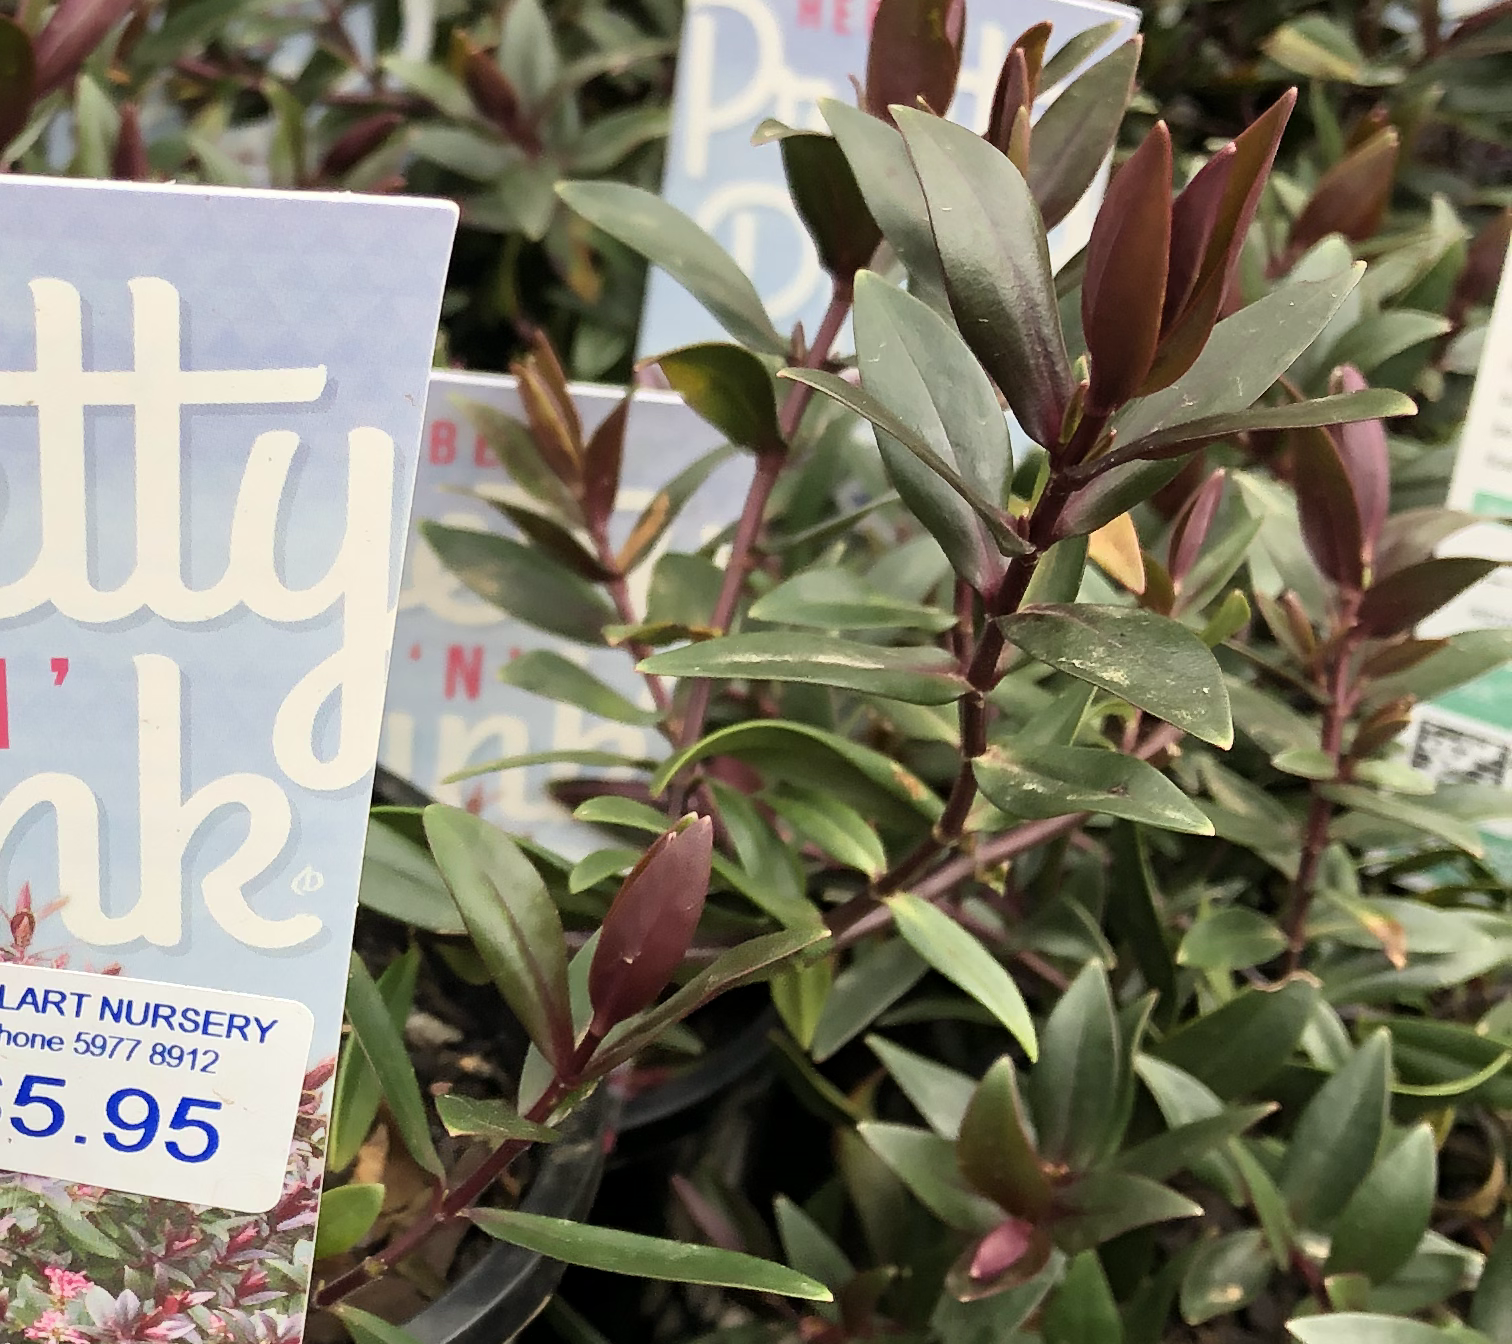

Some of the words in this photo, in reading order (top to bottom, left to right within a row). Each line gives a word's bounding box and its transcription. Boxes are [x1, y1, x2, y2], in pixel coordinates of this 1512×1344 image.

[99, 994, 279, 1045] NURSERY
[73, 1033, 141, 1063] 5977
[147, 1045, 221, 1075] 8912
